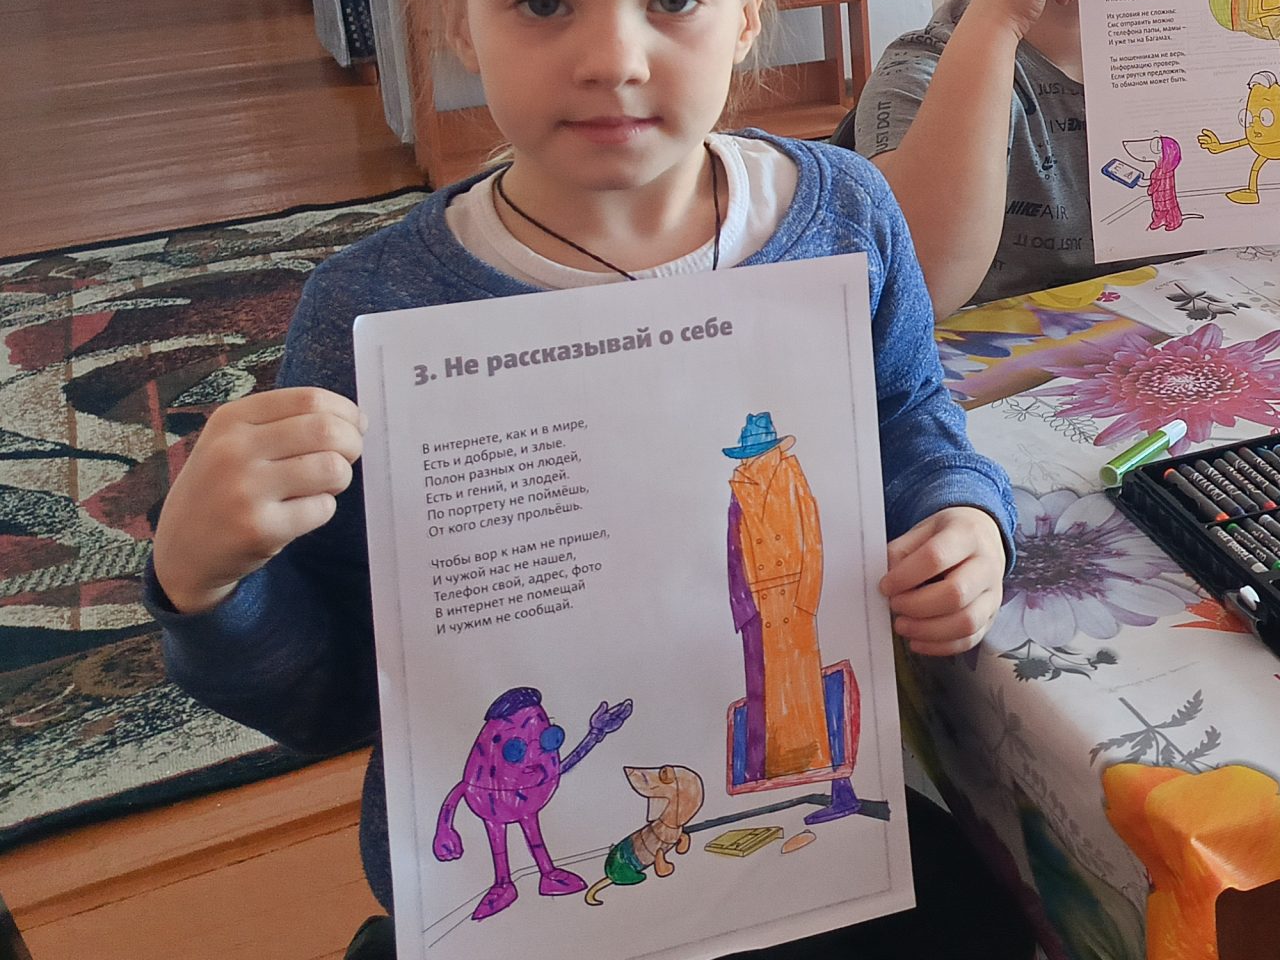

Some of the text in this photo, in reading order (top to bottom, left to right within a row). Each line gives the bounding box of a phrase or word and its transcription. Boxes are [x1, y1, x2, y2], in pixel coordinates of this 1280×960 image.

[1120, 18, 1151, 28] отправить
[875, 131, 889, 152] UST
[1007, 200, 1069, 220] NIKE AIR
[414, 317, 732, 386] 3. Не рассказывай о себе
[422, 420, 587, 455] В интернете, как и в мире,
[424, 440, 566, 471] Есть и добрые, и злые.
[425, 451, 581, 487] Полон разных он людей,
[426, 469, 569, 504] Есть и гений, и злодей.
[428, 485, 589, 521] По портрету не поймёшь,
[428, 503, 582, 537] От кого слезу прольёшь.
[431, 530, 610, 569] Чтобы вор к нам не пришел,
[433, 552, 576, 586] И чужой нас не нашел,
[434, 563, 602, 601] Телефон свой, адрес, фото
[435, 580, 585, 619] В интернет не помещай
[437, 599, 573, 635] И чужим не сообщай.
